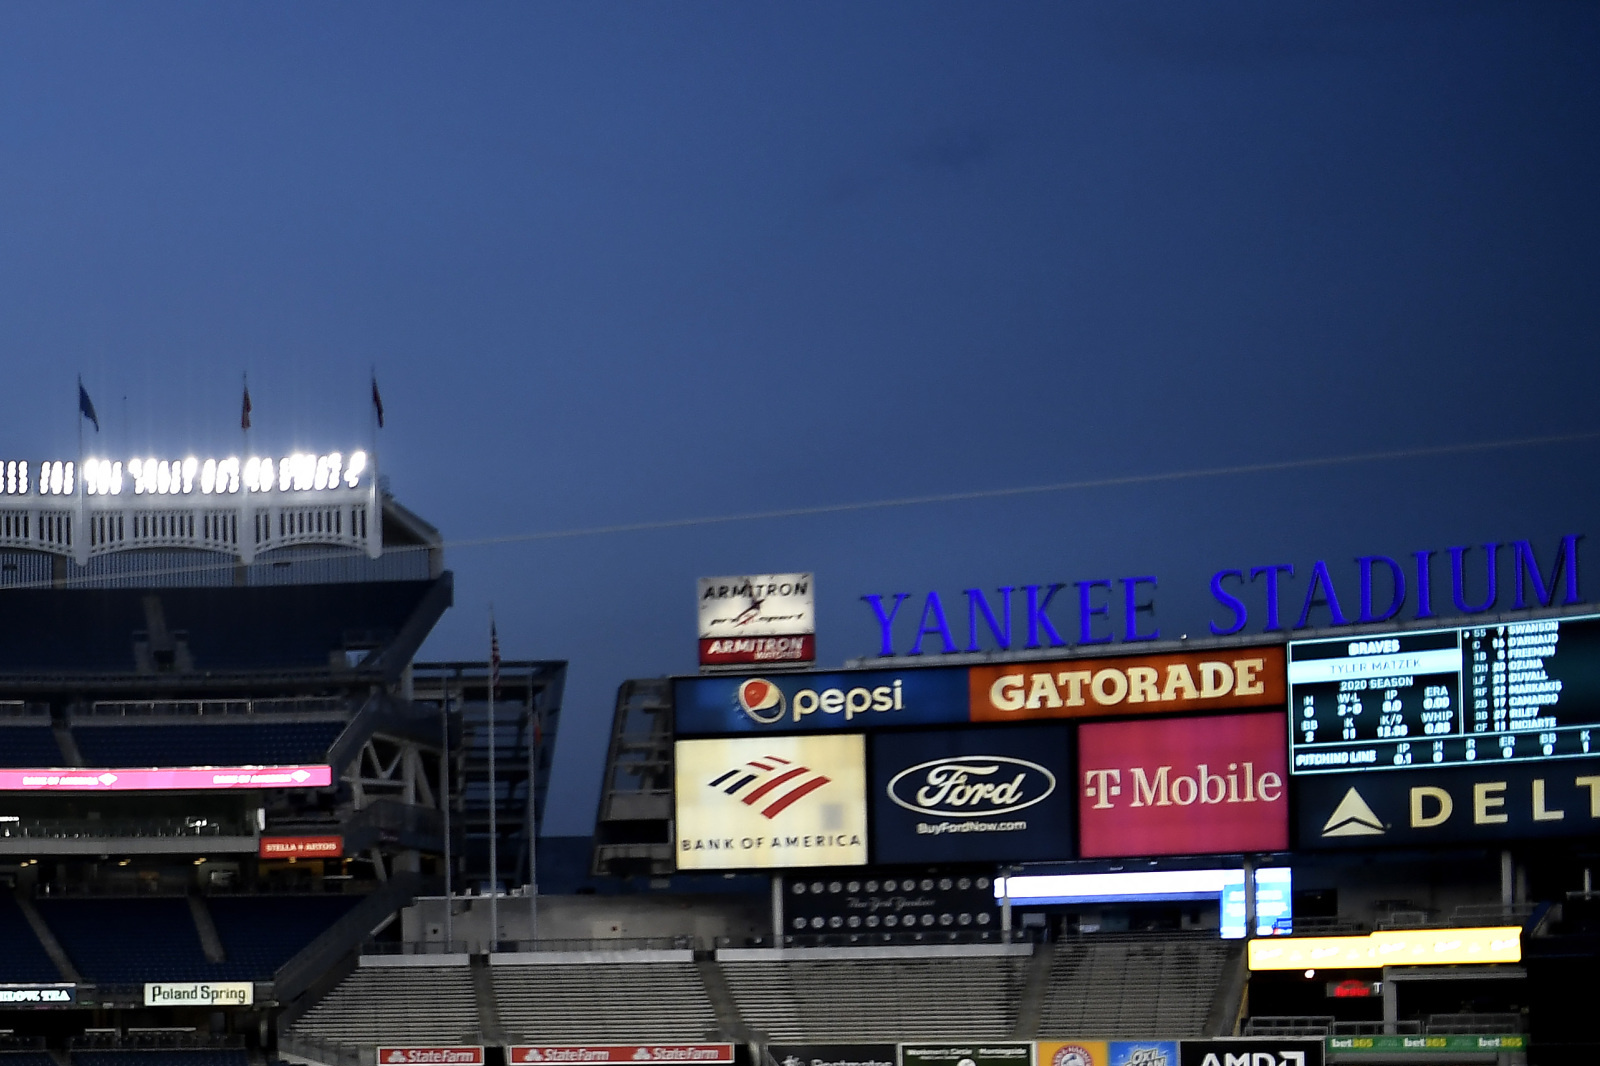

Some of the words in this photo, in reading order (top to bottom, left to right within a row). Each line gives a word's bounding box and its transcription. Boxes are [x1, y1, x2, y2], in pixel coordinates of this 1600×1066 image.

[861, 576, 1161, 657] YANKEE
[1208, 534, 1585, 637] STADIUM
[1508, 621, 1558, 635] SWANSON
[708, 638, 803, 654] ARMITRON
[1348, 639, 1400, 656] BRAVES
[1472, 641, 1480, 650] C
[1508, 633, 1558, 646] D'ARNAUD
[1474, 652, 1487, 661] 1B
[1508, 645, 1555, 658] FREEMAN
[1330, 663, 1366, 675] TYLER
[1372, 659, 1421, 672] MATZEK
[1473, 664, 1488, 673] DH
[1508, 659, 1543, 671] OZUNA
[1340, 680, 1367, 691] 2020
[1369, 676, 1413, 689] SEASON
[1473, 676, 1485, 685] LF
[1508, 670, 1548, 682] DUVALL
[989, 661, 1266, 711] GATORADE
[1473, 687, 1487, 697] RF
[1508, 680, 1562, 694] MARKAKIS
[792, 680, 904, 722] pepsi
[1304, 695, 1314, 705] H
[1385, 690, 1398, 700] IP
[1424, 686, 1448, 697] ERA
[1474, 699, 1488, 709] 2B
[1509, 694, 1558, 706] CAMARGO
[1301, 720, 1318, 731] BB
[1344, 718, 1353, 728] K
[1380, 714, 1402, 725] K/9
[1421, 711, 1453, 723] WHIP
[1509, 707, 1539, 719] RILEY
[1474, 723, 1488, 732] CF
[1510, 717, 1556, 730] INCIARTE
[1305, 731, 1314, 742] 2
[1343, 728, 1356, 740] 11
[1295, 752, 1349, 766] PITCHING
[1350, 750, 1376, 763] LINE
[1397, 743, 1410, 753] IP
[1433, 741, 1443, 751] H
[1466, 739, 1476, 749] R
[1499, 736, 1515, 747] ER
[1539, 733, 1557, 745] BB
[1580, 730, 1590, 741] K
[1394, 753, 1412, 765] 0.1
[916, 765, 1026, 807] Ford
[1130, 762, 1282, 807] Mobile
[916, 821, 1026, 835] BuyFordNow.com
[682, 837, 733, 852] BANK
[741, 837, 765, 850] OF
[771, 833, 862, 849] AMERICA
[42, 990, 70, 1002] TEA
[152, 985, 198, 1000] Poland
[200, 986, 246, 1004] Spring
[1331, 1038, 1373, 1048] bet365
[1403, 1037, 1447, 1048] bet365
[1132, 1049, 1158, 1063] OXI
